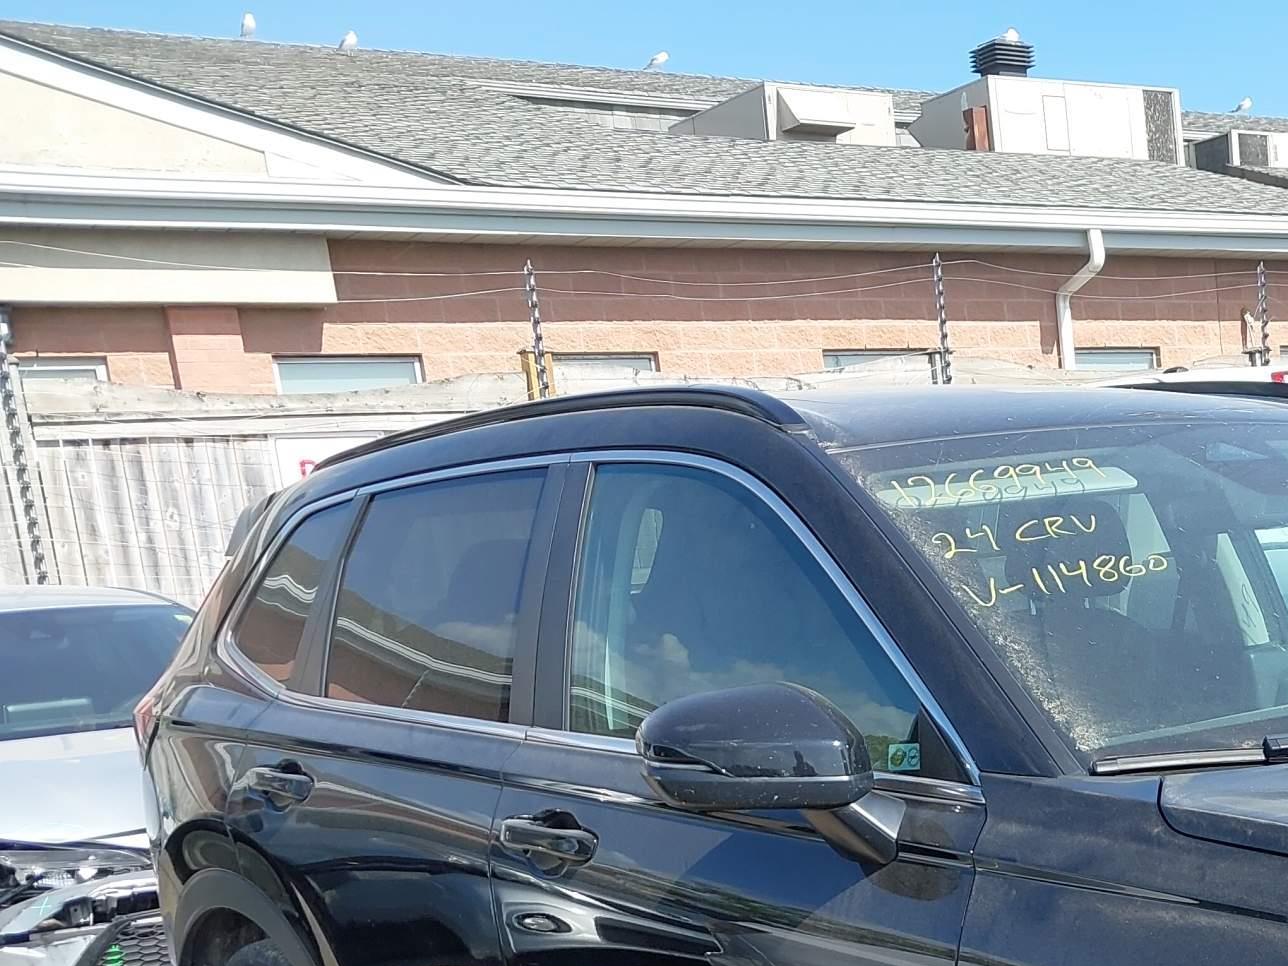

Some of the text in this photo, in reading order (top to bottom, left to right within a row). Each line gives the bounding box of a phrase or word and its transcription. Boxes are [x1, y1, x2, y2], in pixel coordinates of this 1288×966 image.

[891, 457, 1106, 508] 12669949
[931, 515, 1097, 558] 24 CRV
[962, 554, 1168, 607] V-114860
